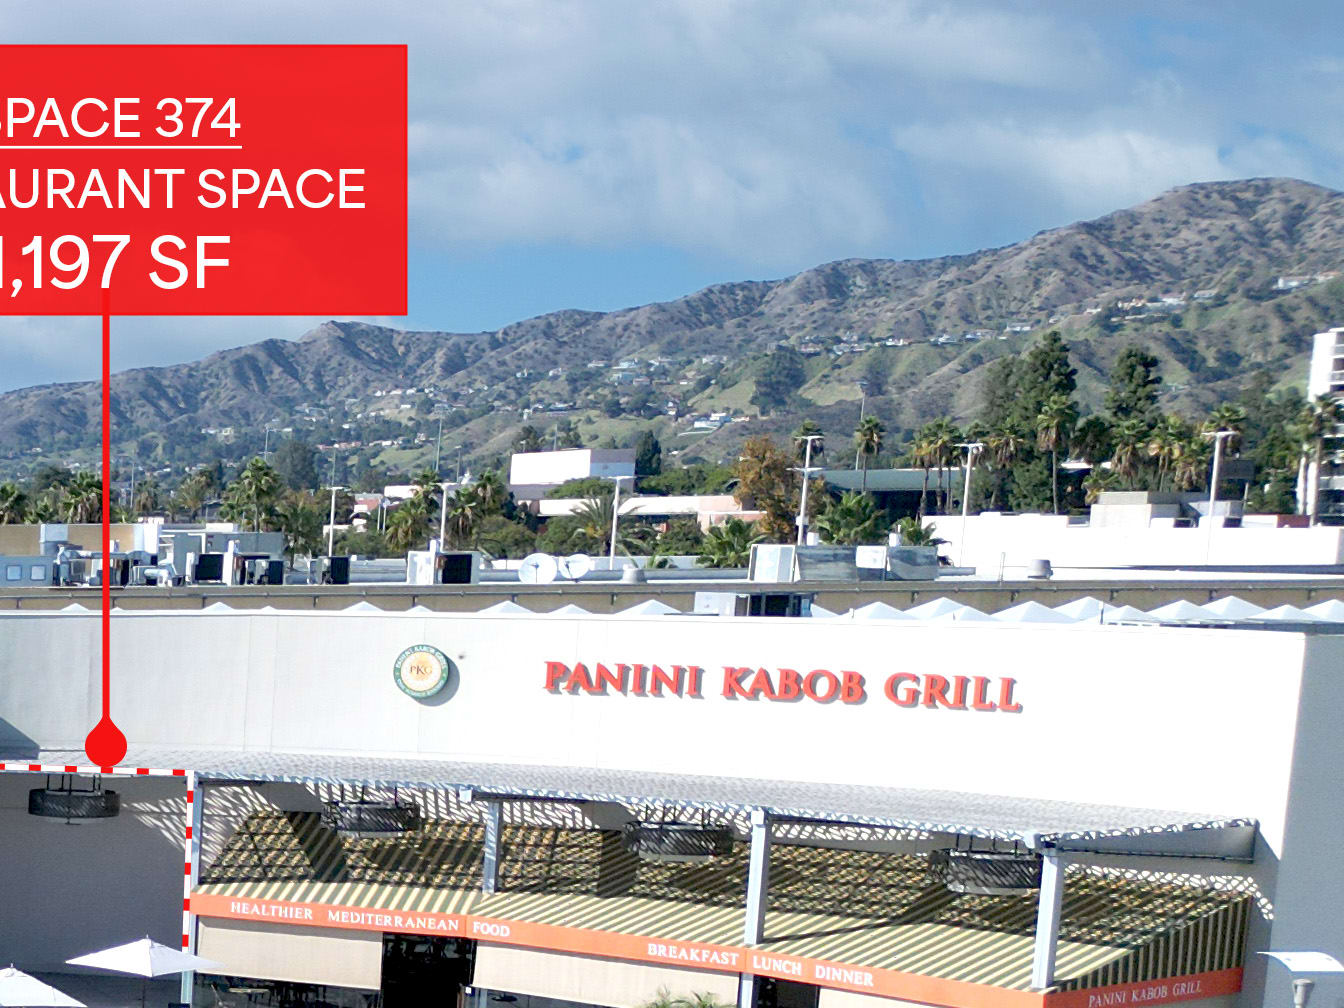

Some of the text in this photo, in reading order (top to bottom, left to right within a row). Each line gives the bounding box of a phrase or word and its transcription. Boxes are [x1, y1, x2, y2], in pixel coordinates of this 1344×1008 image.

[543, 661, 1021, 711] PANINI KABOB GRILL
[230, 902, 510, 937] HEALTHIER MEDITERRANEAN FOOD
[647, 943, 874, 987] BREAKFAST LUNCH DINNER
[1088, 980, 1202, 1008] PANINI KABOB GRILL
